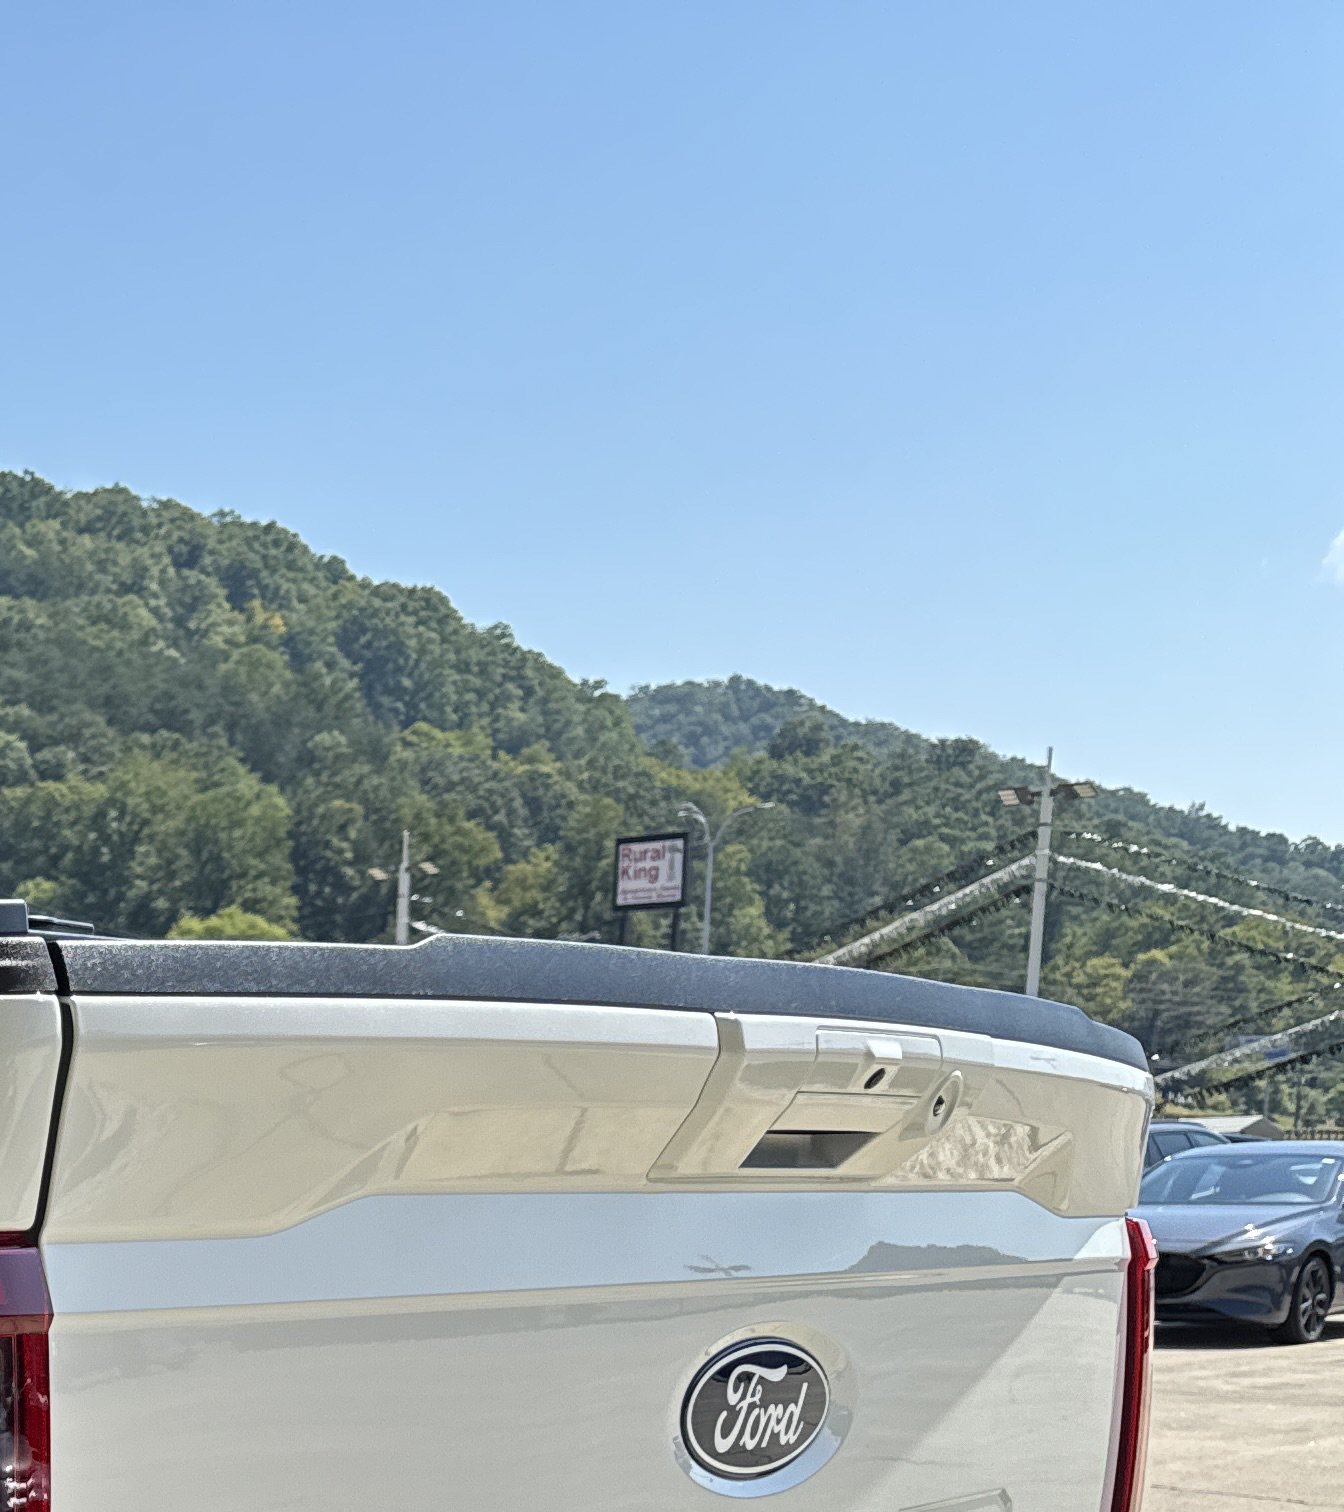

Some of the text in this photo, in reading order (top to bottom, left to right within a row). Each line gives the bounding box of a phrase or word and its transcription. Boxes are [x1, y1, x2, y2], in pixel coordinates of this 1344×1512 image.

[621, 845, 666, 863] Rural
[620, 866, 660, 884] King
[714, 1363, 809, 1453] Ford
